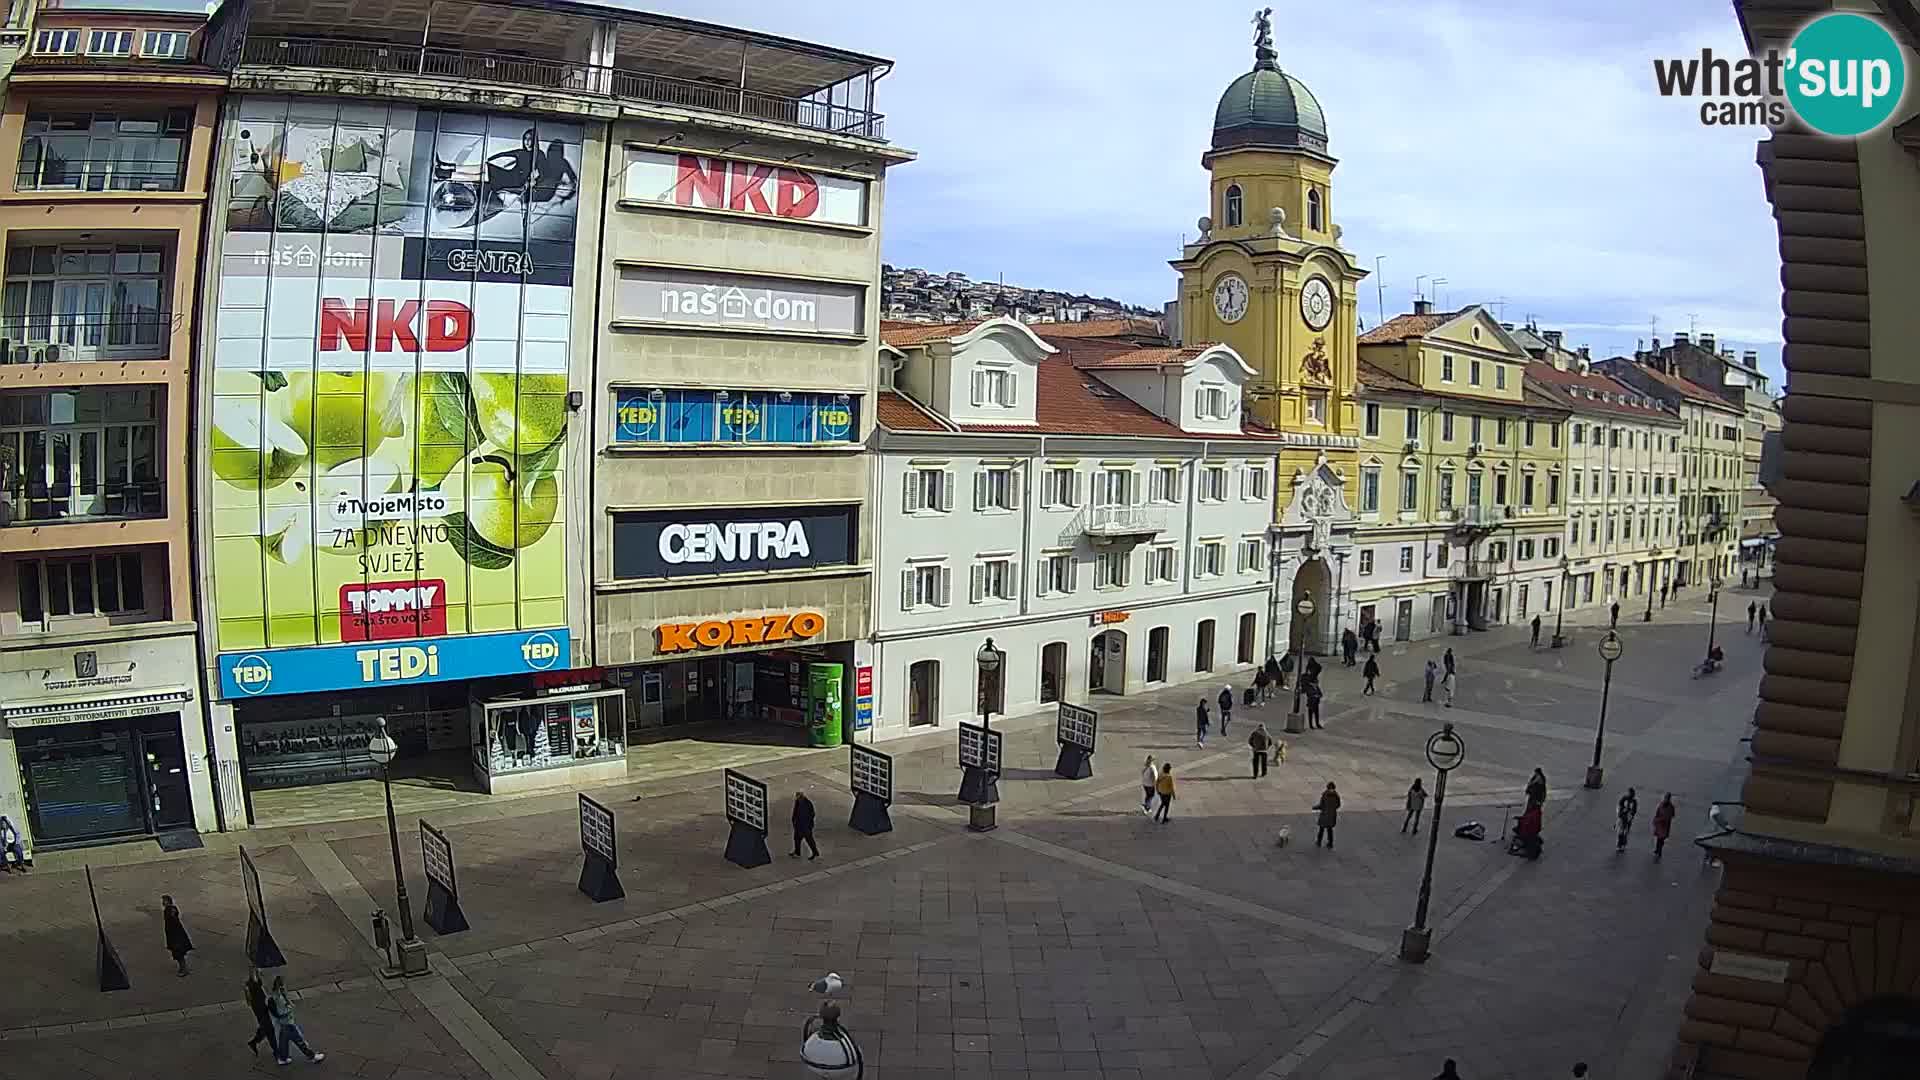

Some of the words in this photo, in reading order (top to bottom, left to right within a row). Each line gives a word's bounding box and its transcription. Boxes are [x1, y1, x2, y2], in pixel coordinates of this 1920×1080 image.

[674, 154, 819, 218] NKD
[447, 249, 534, 275] CENTRA
[661, 285, 717, 315] naš
[752, 289, 816, 322] dom
[319, 297, 476, 353] NKD
[618, 407, 657, 424] TEDi
[722, 408, 759, 424] TEDi
[337, 496, 445, 516] #TvojeMisto
[332, 528, 356, 549] ZA
[365, 523, 449, 548] DNEVNO
[658, 520, 810, 564] CENTRA
[358, 547, 425, 575] SVJEŽE
[347, 586, 438, 614] TOMMY
[378, 613, 399, 625] ŠTO
[401, 610, 432, 623] VOIŠ.
[656, 612, 824, 653] KORZO
[356, 645, 440, 683] TEDi
[521, 639, 559, 662] TEDi
[232, 662, 273, 685] TEDi
